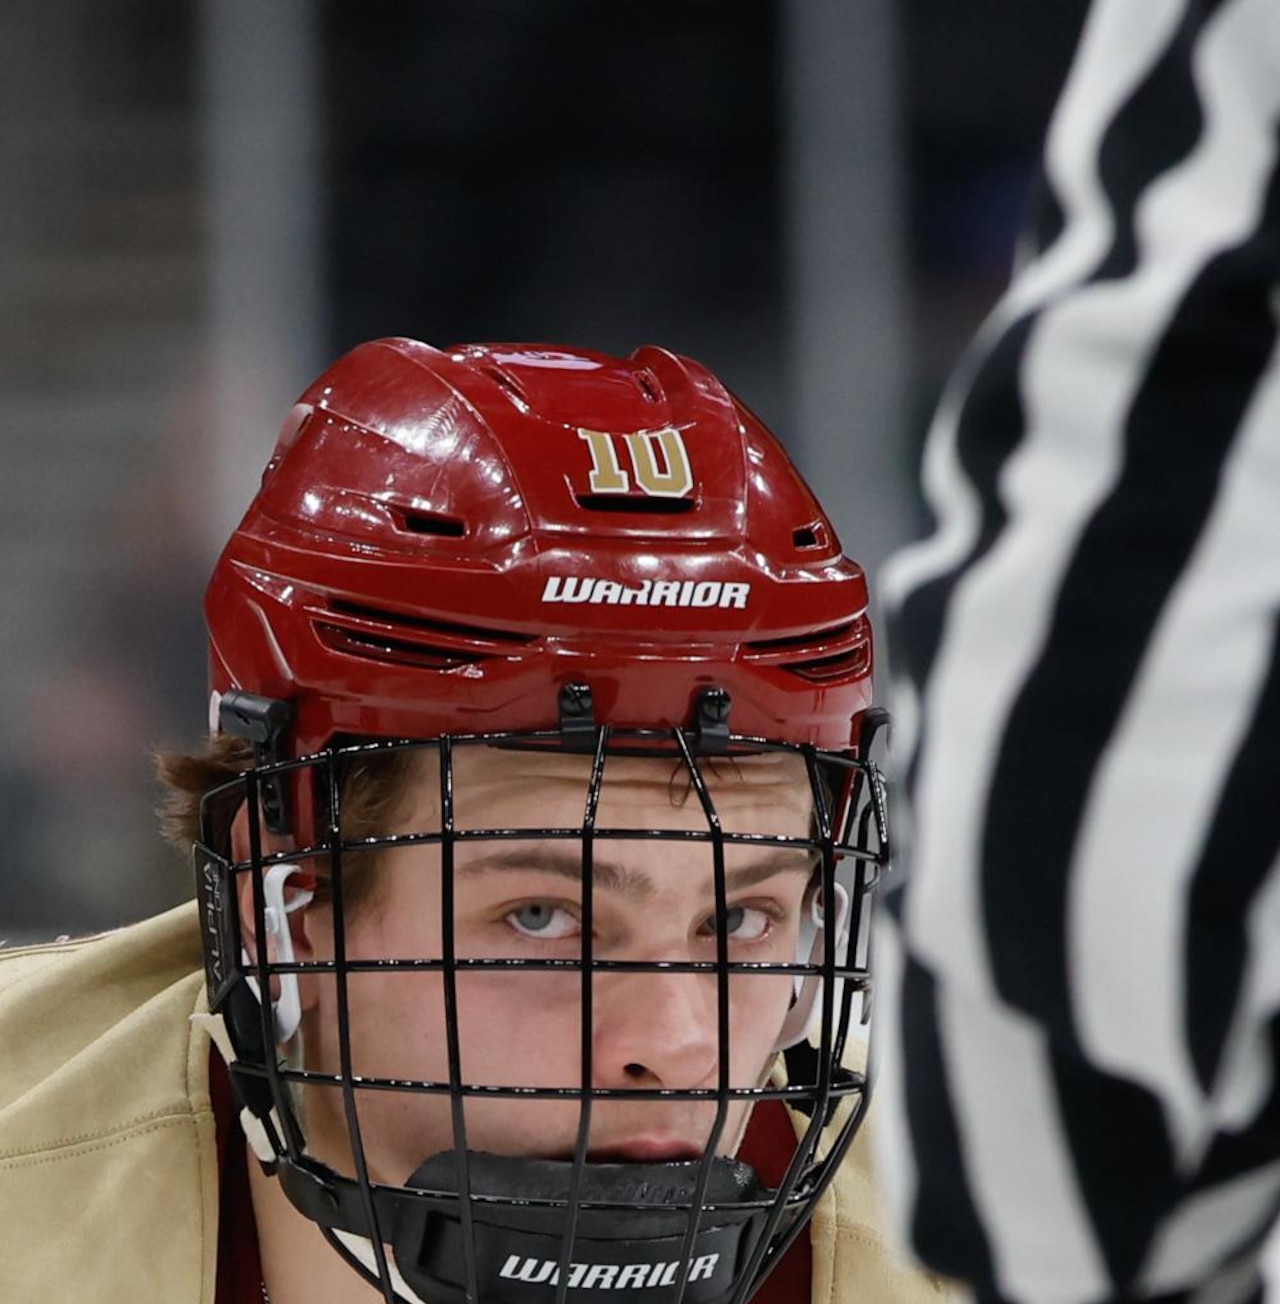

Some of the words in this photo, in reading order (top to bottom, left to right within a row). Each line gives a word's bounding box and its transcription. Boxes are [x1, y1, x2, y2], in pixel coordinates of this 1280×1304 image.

[577, 428, 694, 498] 10
[541, 576, 751, 609] WARRIOR
[203, 862, 223, 983] ALPHA
